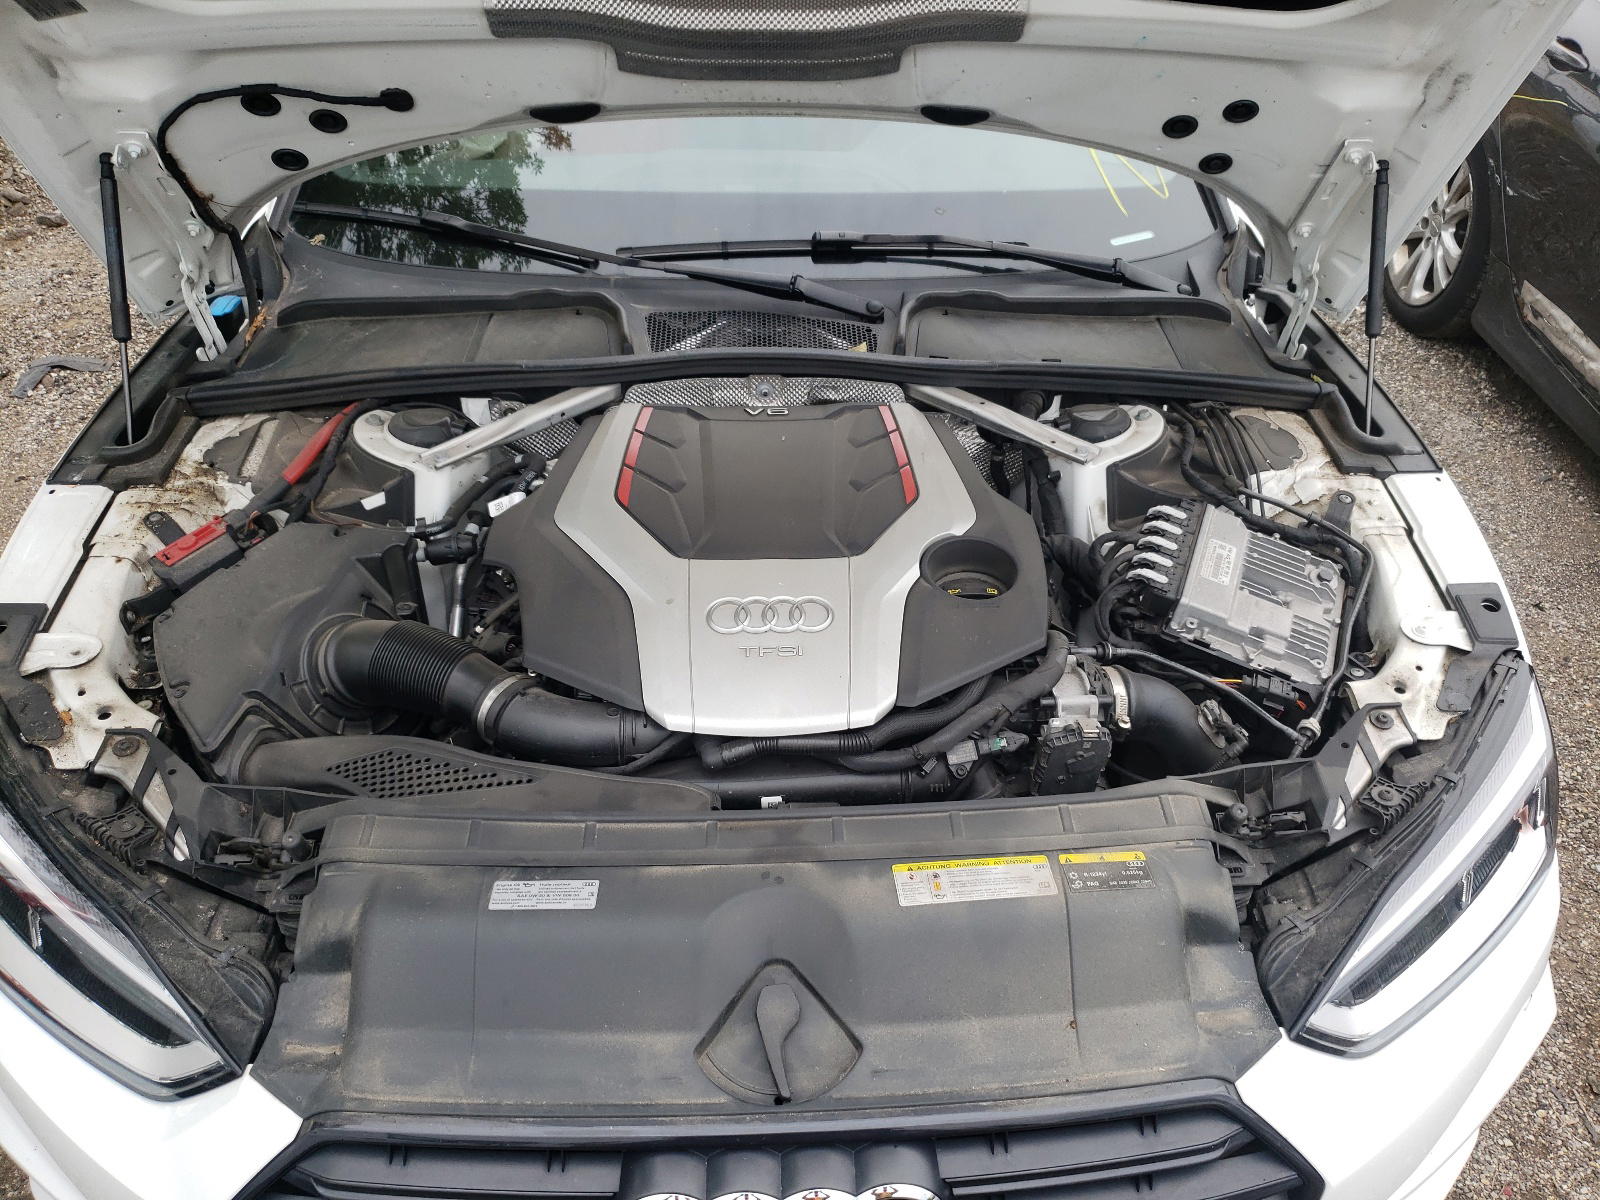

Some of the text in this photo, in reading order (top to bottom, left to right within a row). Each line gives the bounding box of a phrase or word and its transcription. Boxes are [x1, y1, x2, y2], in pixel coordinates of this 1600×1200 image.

[744, 407, 789, 416] V6
[738, 645, 804, 657] TFSI
[916, 863, 951, 872] ACHTUNG
[993, 858, 1032, 866] ATTENTION
